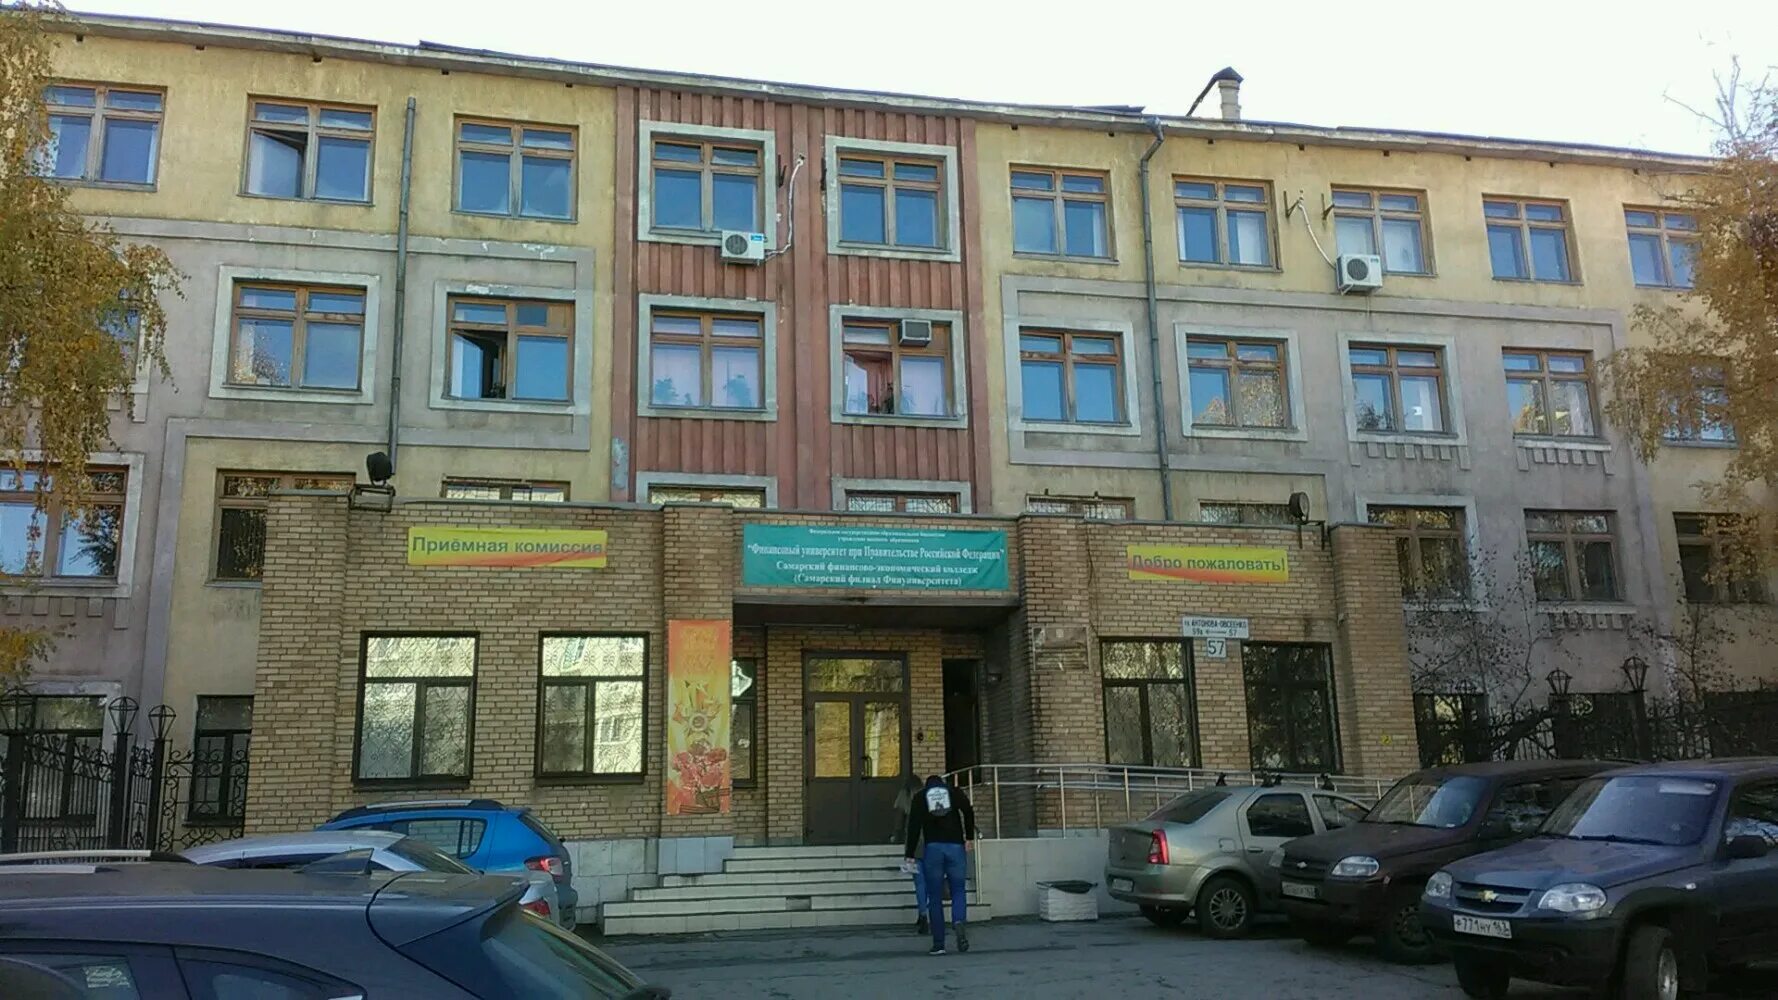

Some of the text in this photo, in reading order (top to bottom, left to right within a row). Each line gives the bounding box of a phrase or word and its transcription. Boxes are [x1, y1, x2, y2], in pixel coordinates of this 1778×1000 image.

[412, 536, 602, 554] Приёмная комиссия
[801, 546, 847, 558] университет
[849, 548, 862, 559] при
[864, 546, 919, 559] Правительстве
[920, 547, 960, 558] Российский
[776, 560, 826, 572] Самарский
[827, 562, 941, 574] финансово-экономический
[1132, 555, 1285, 572] Добро пожаловать!
[794, 573, 962, 587] (Самарский филиал Финуниверситета)
[1207, 640, 1225, 655] 57
